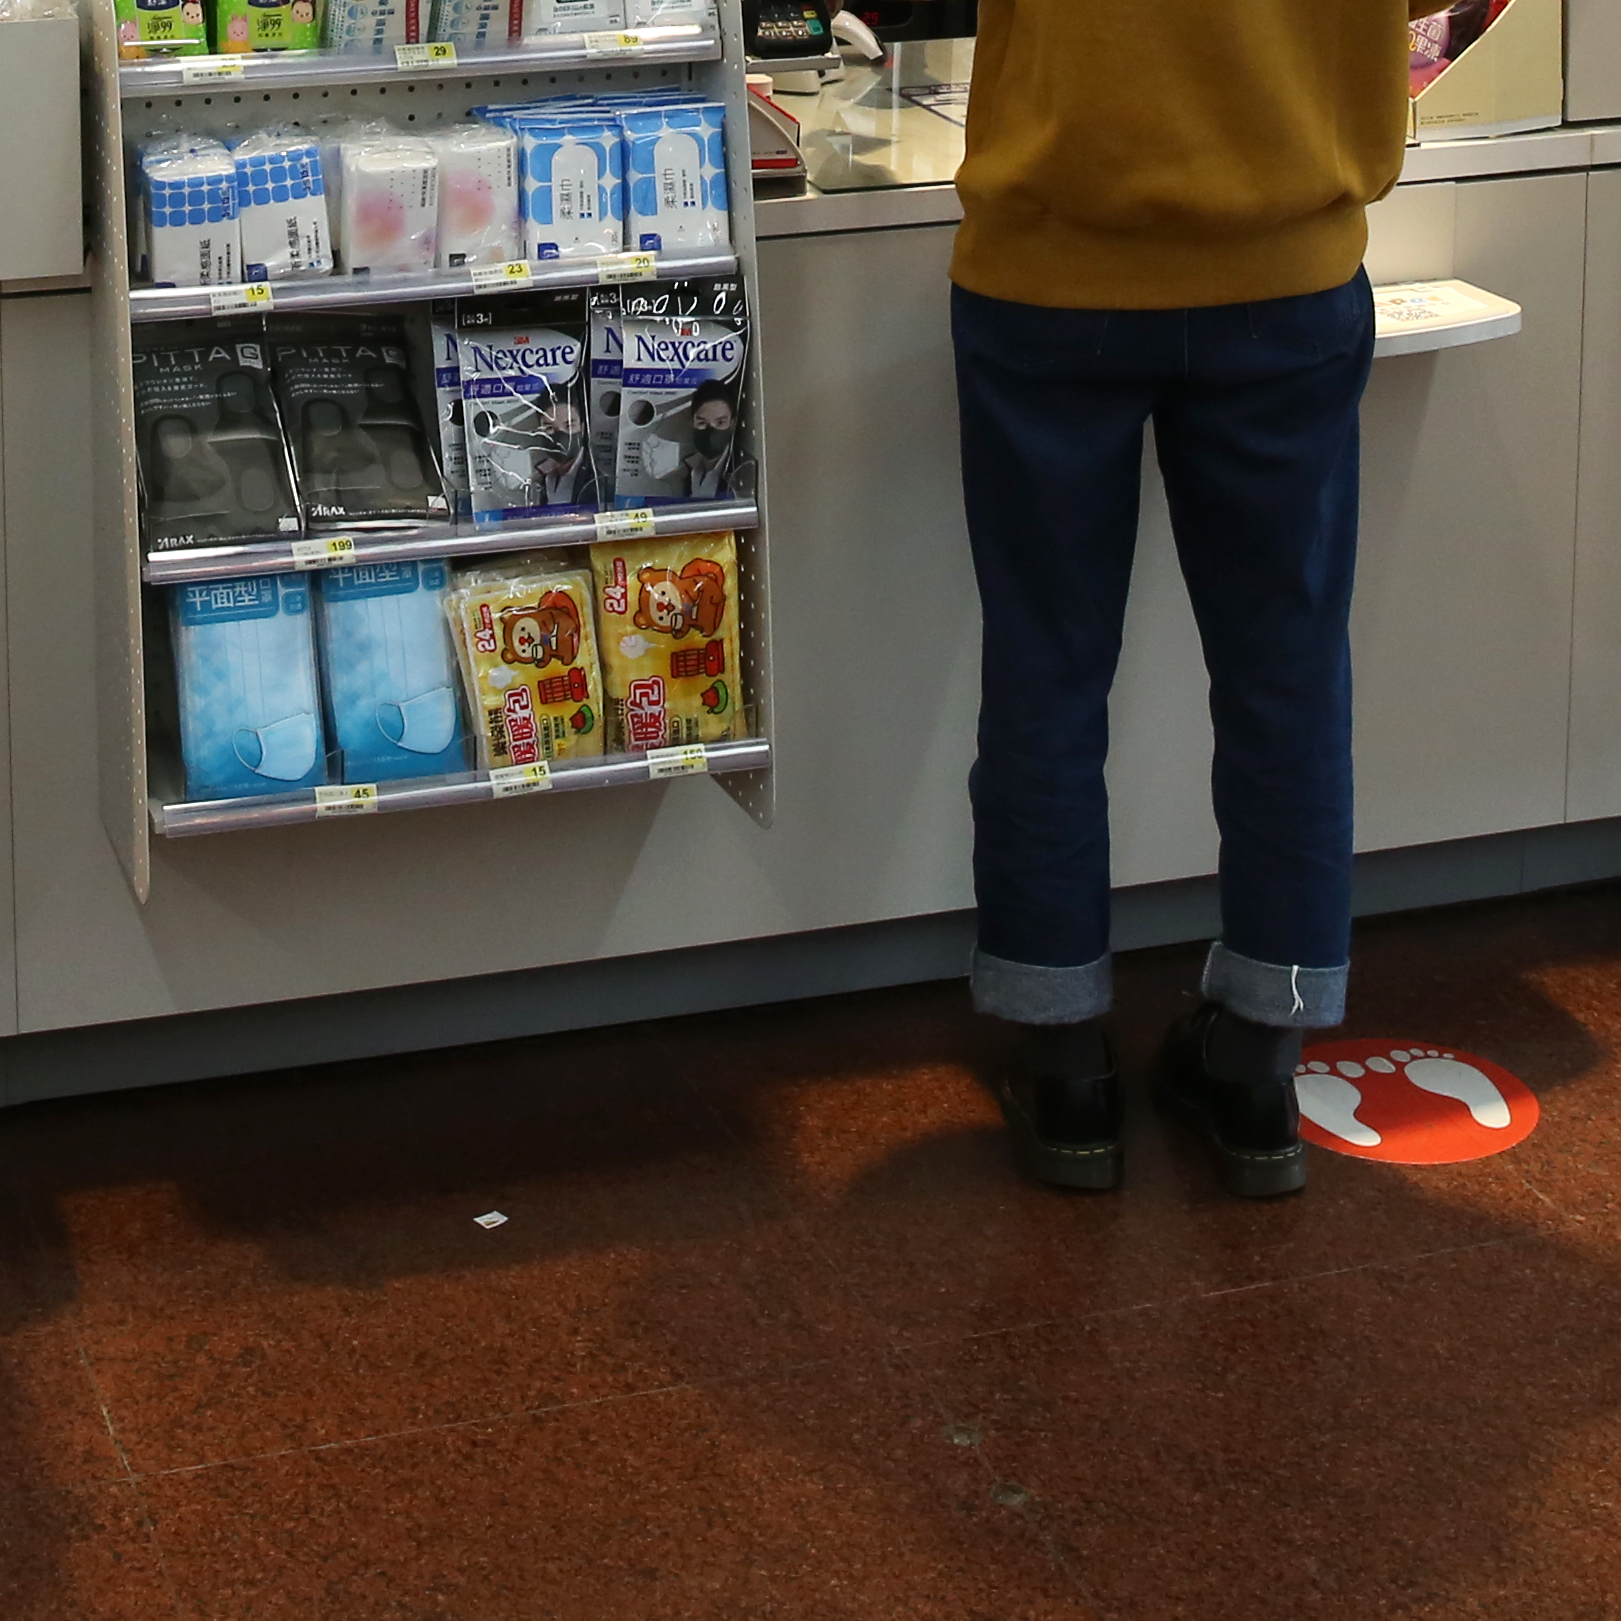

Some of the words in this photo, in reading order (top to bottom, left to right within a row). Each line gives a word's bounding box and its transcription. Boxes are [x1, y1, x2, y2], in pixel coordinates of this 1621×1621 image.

[433, 46, 447, 56] 29
[507, 264, 523, 275] 23
[249, 285, 265, 297] 15
[635, 335, 735, 364] Nexcare
[471, 341, 577, 375] Nexcare
[331, 540, 353, 552] 199
[186, 580, 258, 609] 平面型
[531, 765, 547, 778] 15
[353, 788, 370, 800] 45
